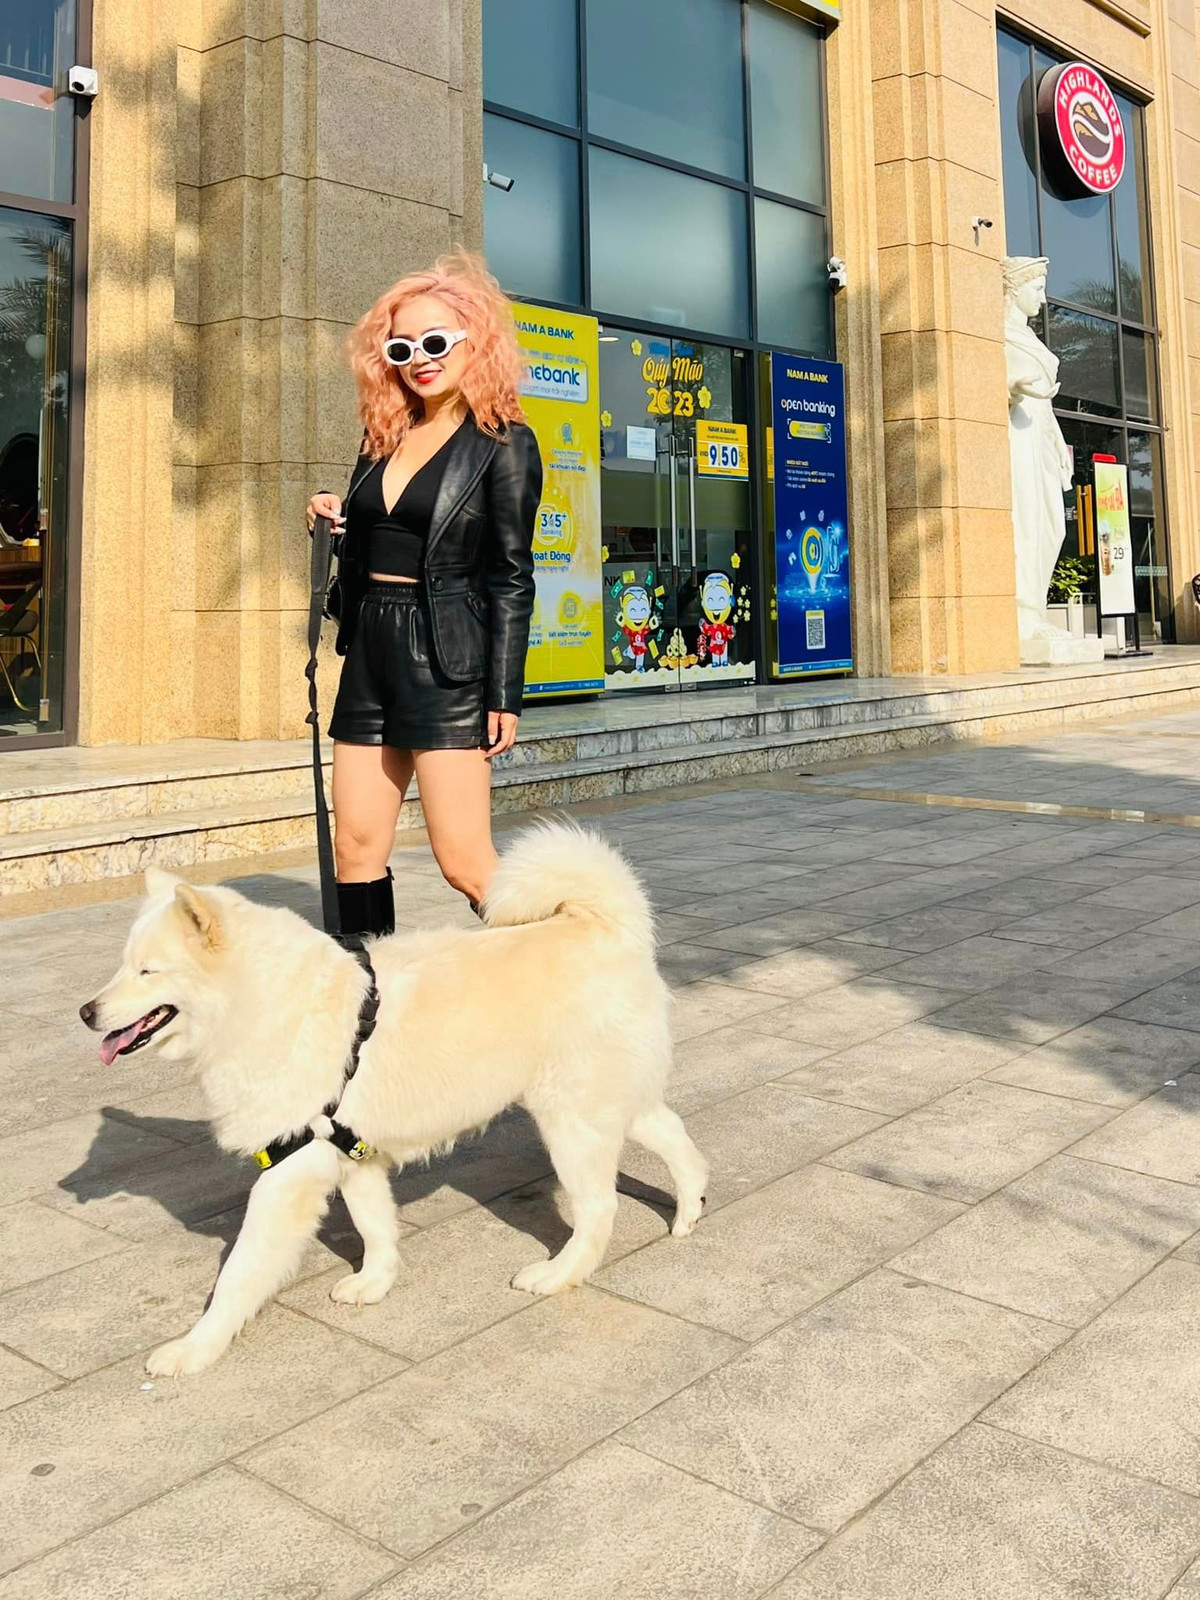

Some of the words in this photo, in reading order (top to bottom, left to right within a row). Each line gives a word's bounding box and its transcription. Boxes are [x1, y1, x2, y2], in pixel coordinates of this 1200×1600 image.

[1059, 71, 1121, 137] HIGHLANDS
[1069, 144, 1118, 186] COFFEE
[514, 320, 537, 334] NAM
[539, 325, 546, 335] A
[547, 326, 575, 340] BANK
[642, 356, 670, 388] Quý
[786, 368, 804, 380] NAM
[804, 372, 809, 381] A
[809, 372, 829, 384] BANK
[646, 386, 694, 417] 2023
[1113, 547, 1124, 560] 29
